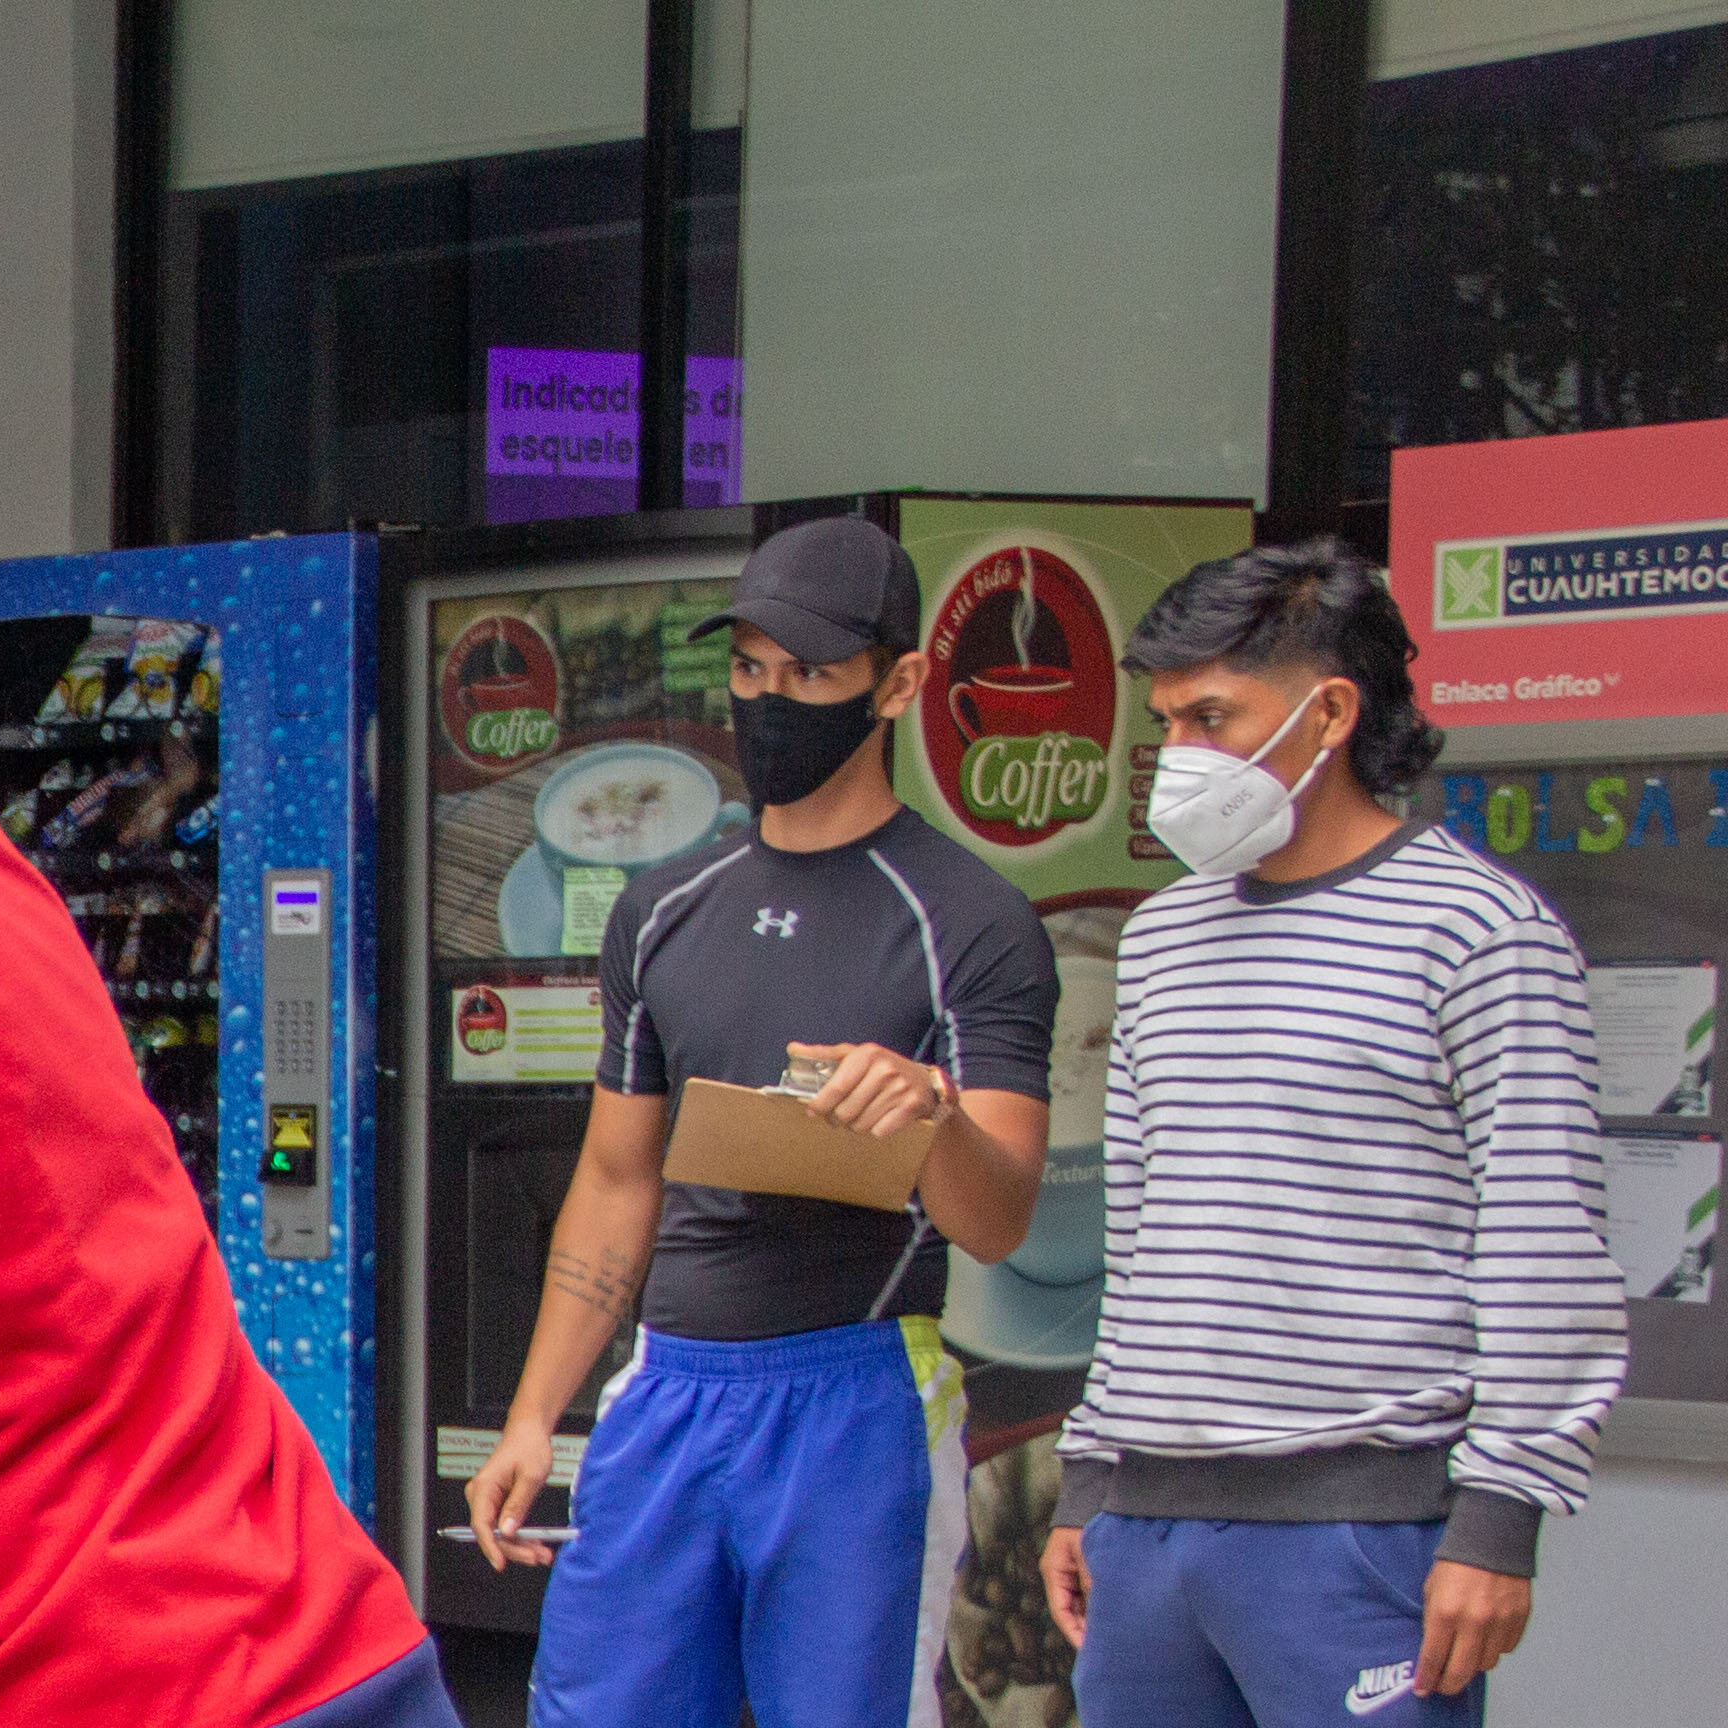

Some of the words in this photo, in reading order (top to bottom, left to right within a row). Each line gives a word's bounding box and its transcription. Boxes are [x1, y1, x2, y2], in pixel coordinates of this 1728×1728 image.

[1432, 678, 1509, 705] Enlace
[1514, 672, 1602, 702] Gráfico
[471, 708, 554, 757] Coffer
[970, 738, 1105, 828] Coffer
[1442, 771, 1681, 855] BOLSA
[1356, 1659, 1414, 1695] NIKE
